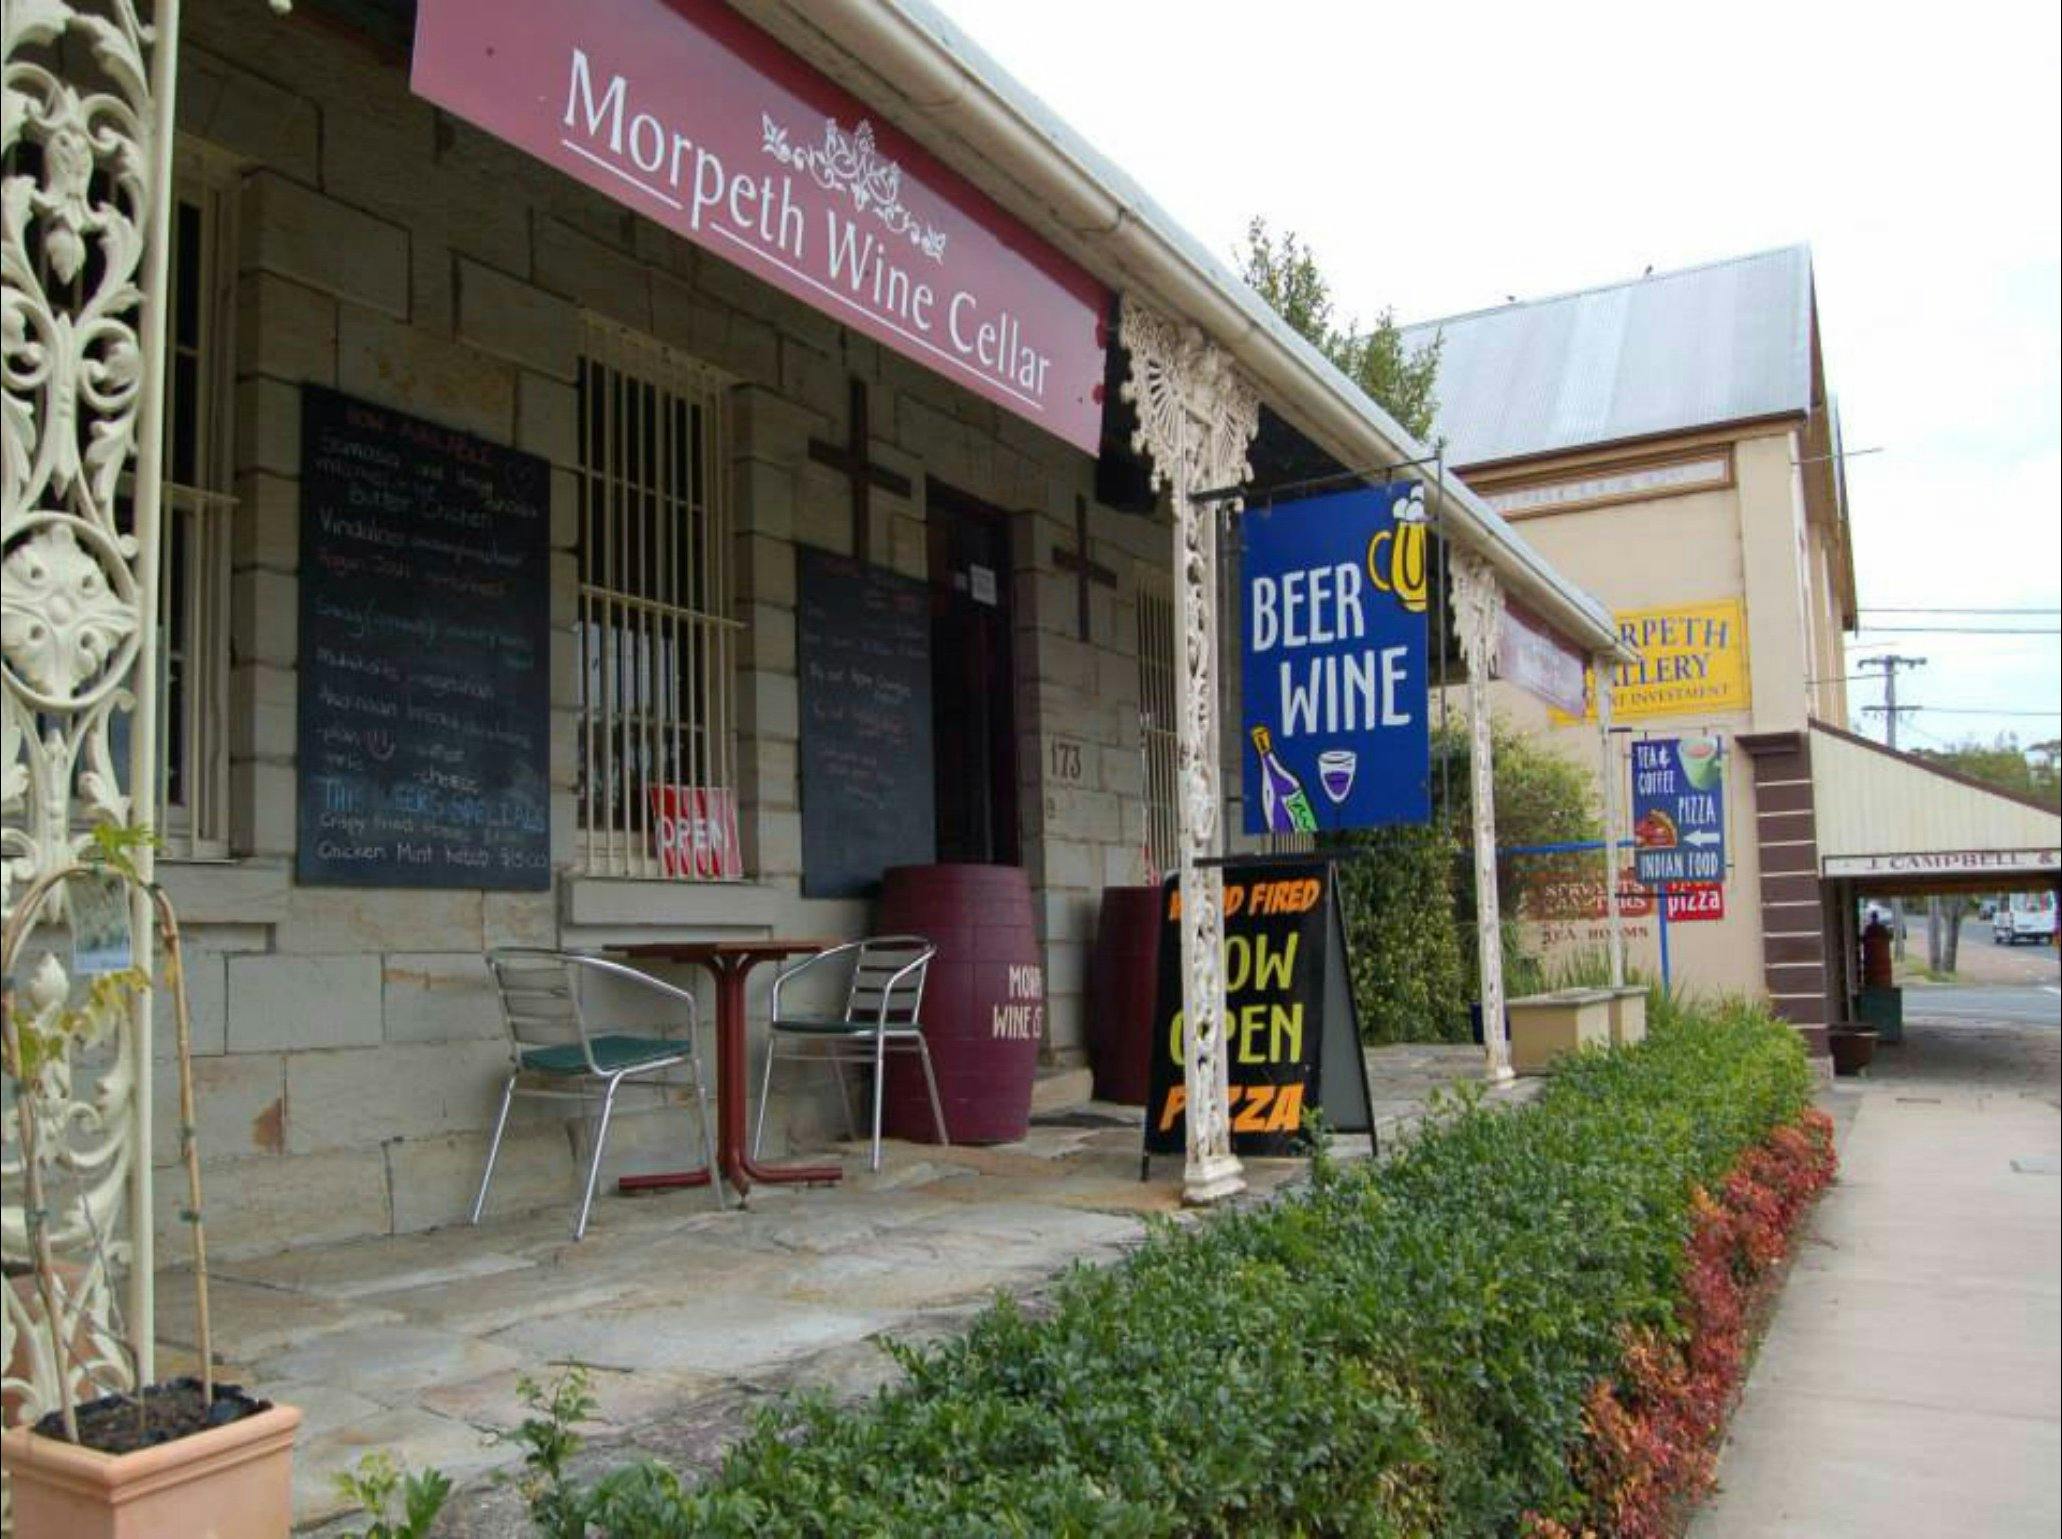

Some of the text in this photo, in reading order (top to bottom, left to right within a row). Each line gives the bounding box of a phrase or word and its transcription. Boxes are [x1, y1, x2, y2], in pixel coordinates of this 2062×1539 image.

[563, 48, 1051, 397] Morpeth Wine Cellar
[1252, 562, 1365, 652] BEER
[1280, 646, 1412, 738] WINE
[1050, 742, 1082, 779] 173
[1637, 745, 1658, 770] TEA
[1637, 770, 1676, 796] COFFEE
[1678, 795, 1717, 825] PIZZA
[655, 818, 730, 851] OPEN
[396, 841, 433, 864] Mint
[1641, 850, 1719, 879] INDIAN FOOD
[1889, 850, 2025, 870] CAMPBELL
[1248, 878, 1321, 917] FIRED
[1667, 890, 1721, 919] pizza
[1223, 931, 1299, 994] OW
[992, 1003, 1031, 1040] WINE
